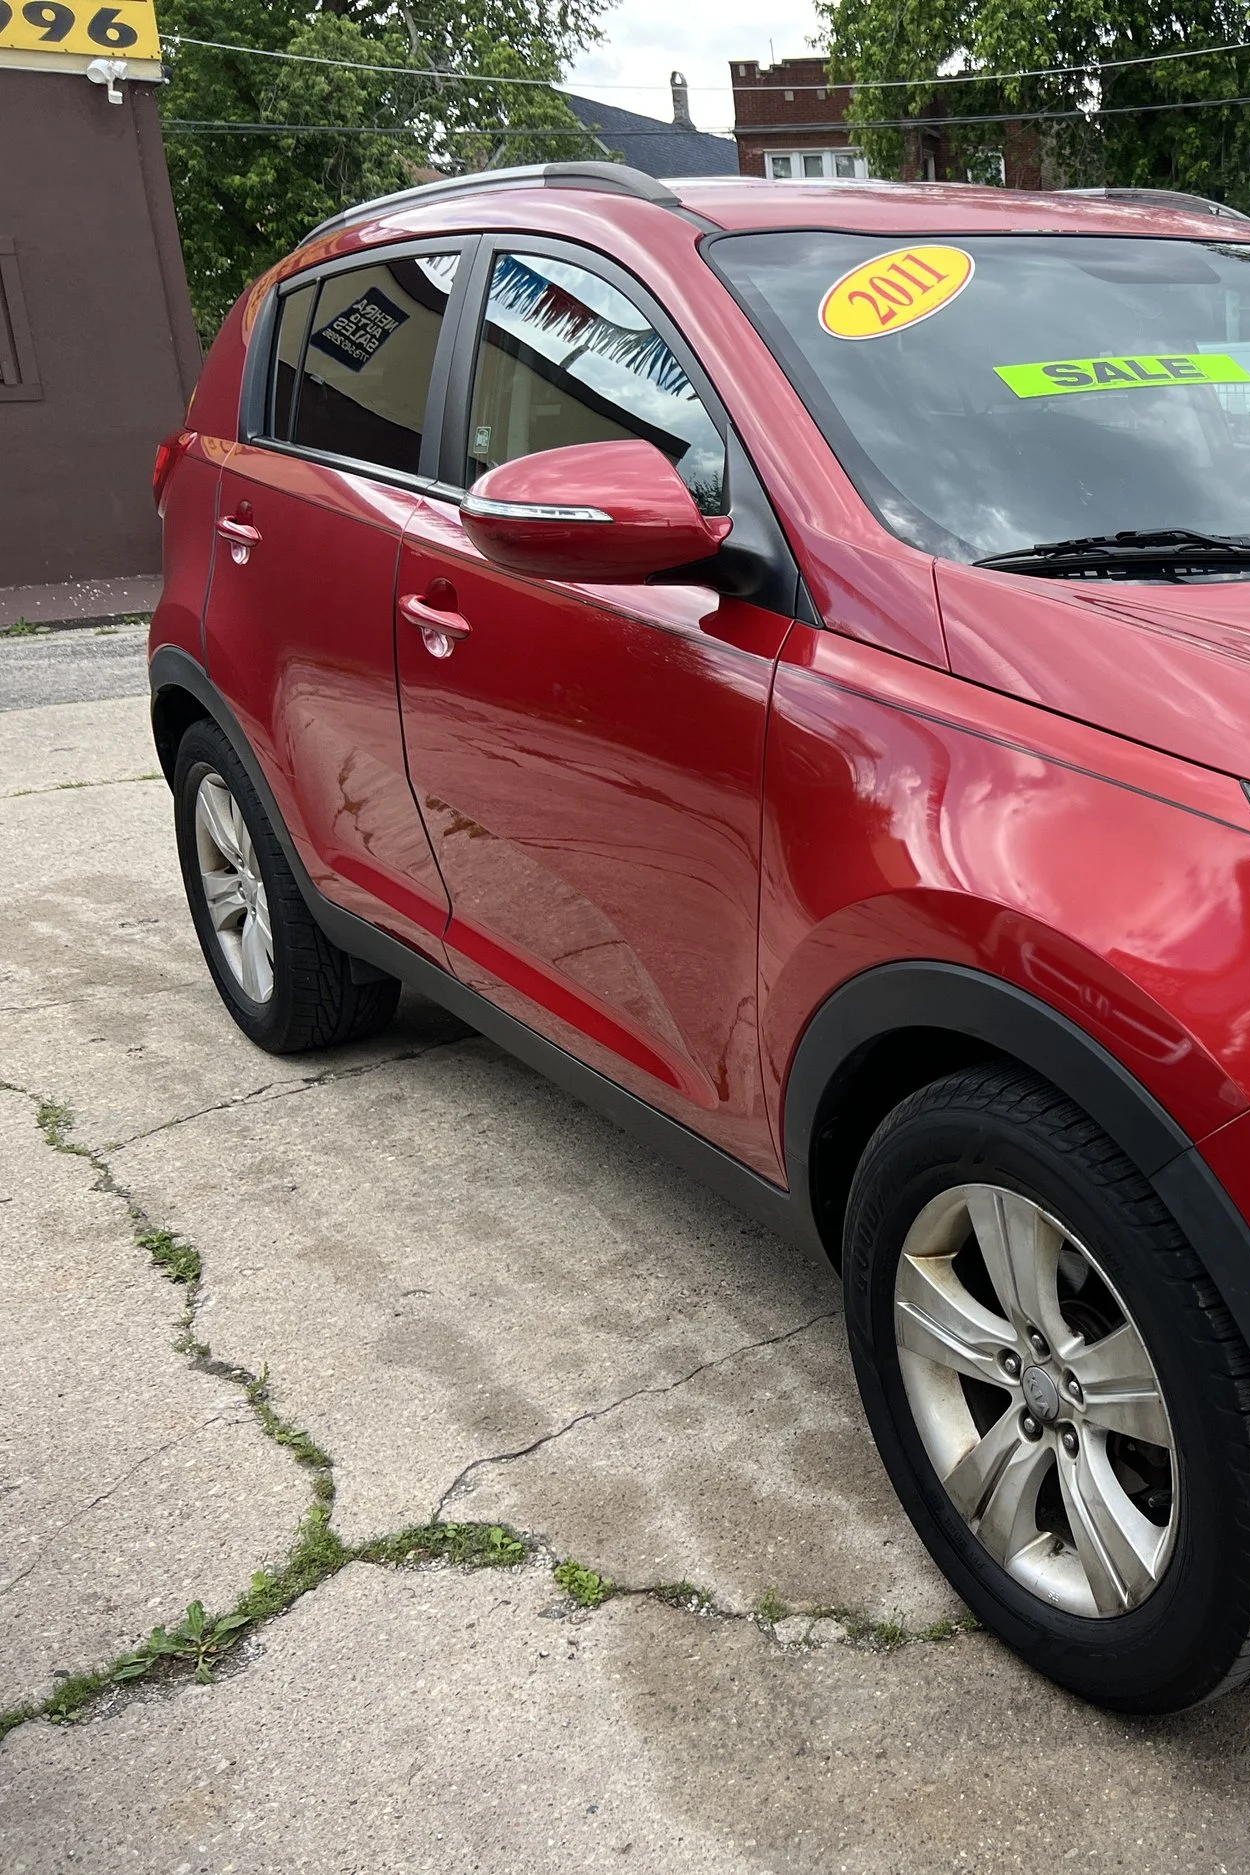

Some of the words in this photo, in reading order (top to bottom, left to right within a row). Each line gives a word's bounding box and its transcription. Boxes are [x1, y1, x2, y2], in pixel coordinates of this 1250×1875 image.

[0, 0, 138, 48] 96
[848, 253, 948, 326] 2011
[1042, 357, 1203, 387] SALE
[1027, 1371, 1050, 1417] KIA
